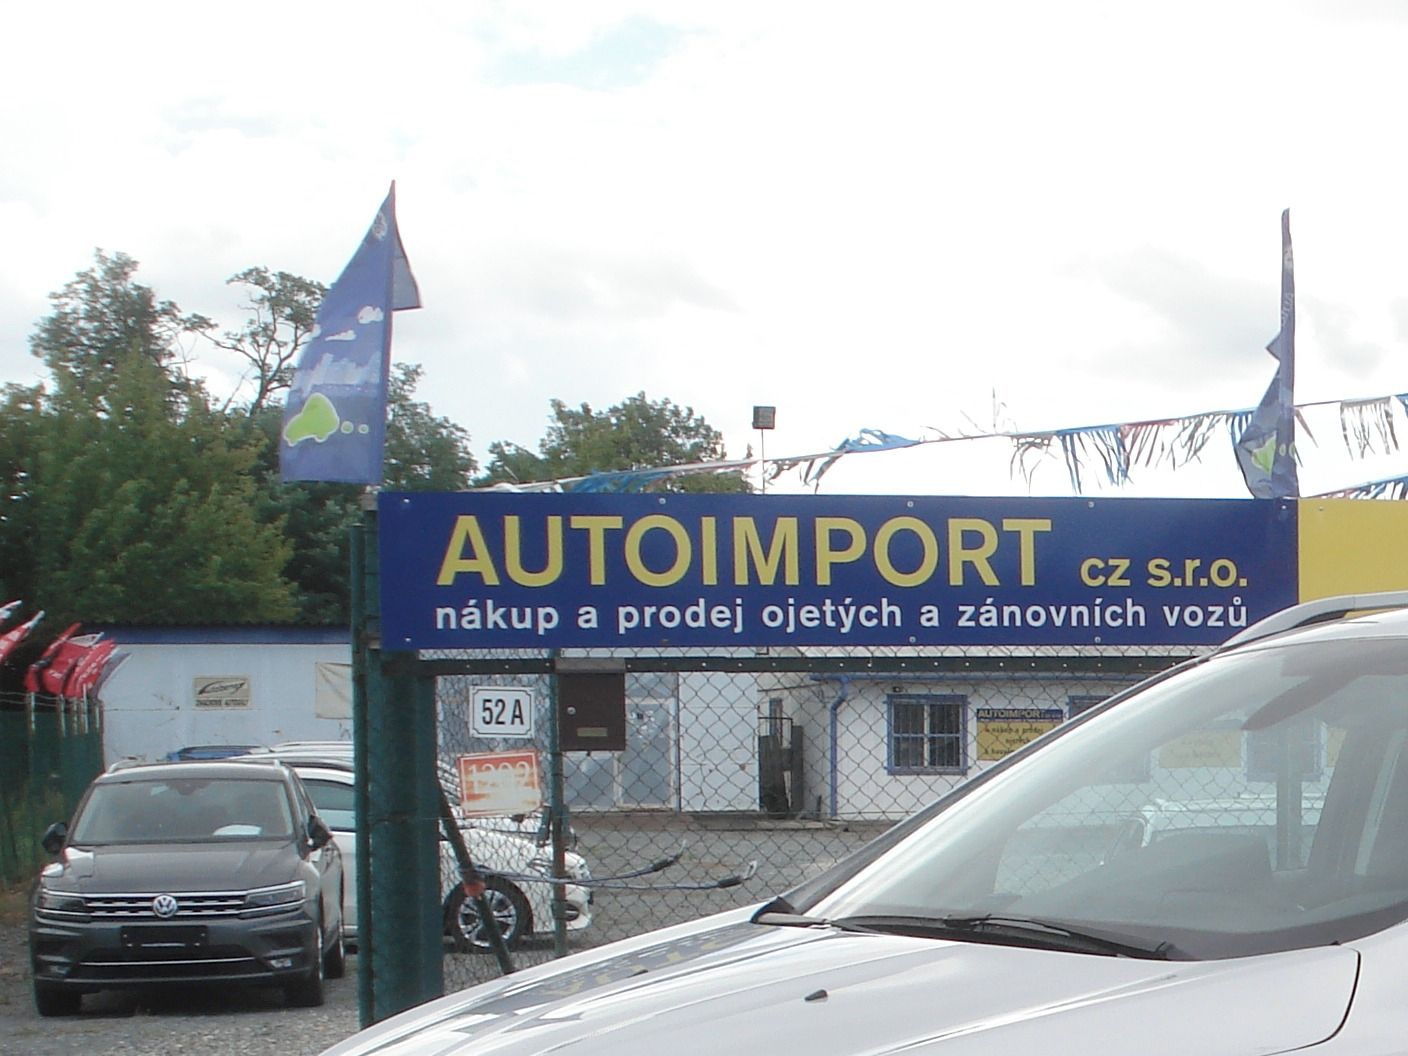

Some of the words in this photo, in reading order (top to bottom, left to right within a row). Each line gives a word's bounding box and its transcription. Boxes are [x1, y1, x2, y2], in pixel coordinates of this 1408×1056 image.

[436, 514, 1052, 588] AUTOIMPORT
[1080, 557, 1131, 588] cz
[1147, 558, 1248, 588] s.r.o.
[436, 599, 559, 635] nákup
[577, 604, 599, 629] a
[618, 598, 743, 634] prodej
[762, 597, 902, 633] ojetých
[919, 604, 940, 628] a
[957, 597, 1146, 628] zánovních
[1162, 596, 1248, 628] vozů
[482, 698, 506, 726] 52
[510, 698, 524, 726] A
